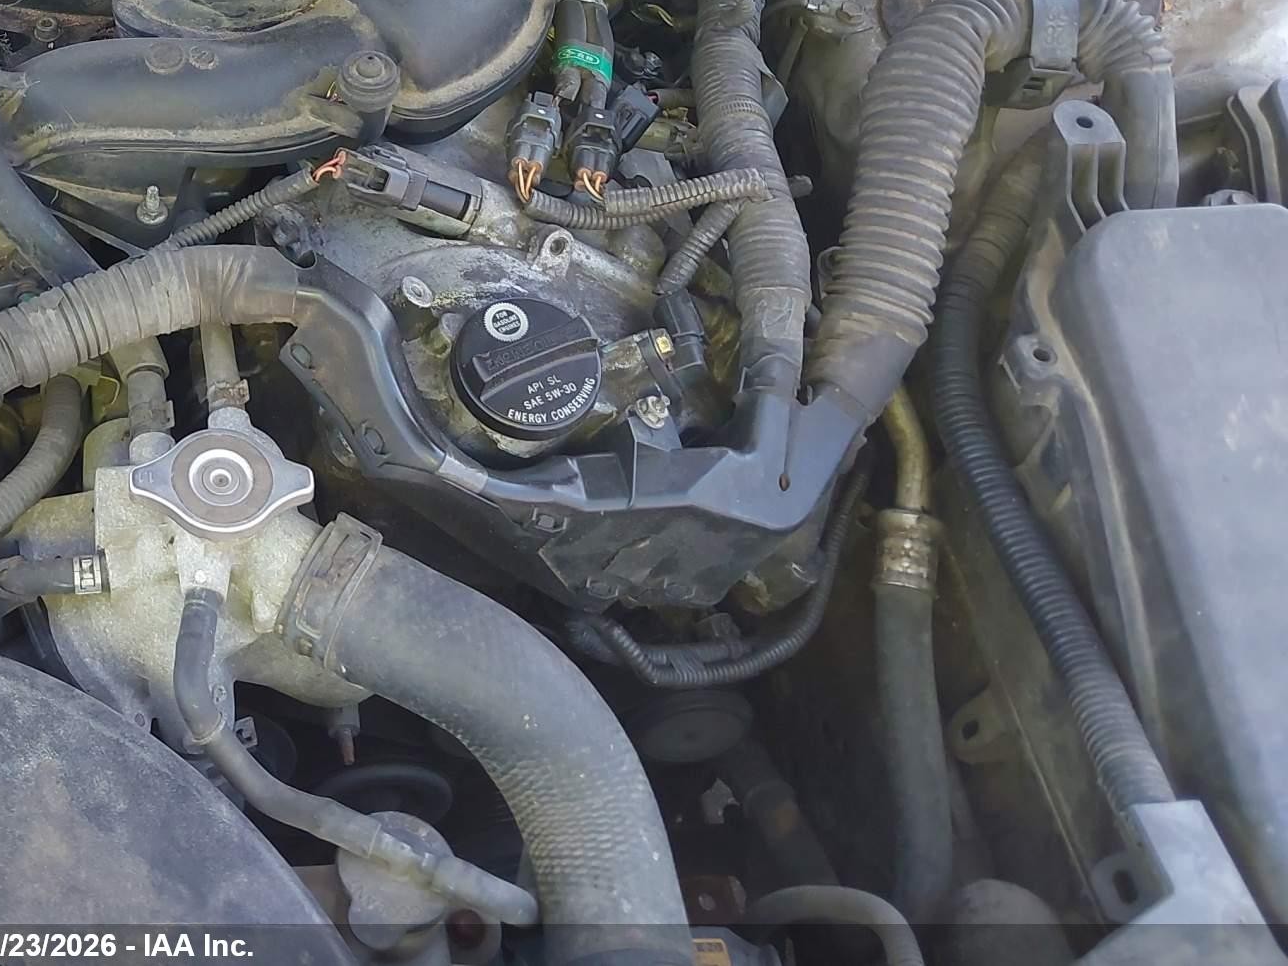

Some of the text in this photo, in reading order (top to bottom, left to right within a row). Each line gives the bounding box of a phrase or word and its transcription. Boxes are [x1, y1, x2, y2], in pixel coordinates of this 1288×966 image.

[493, 314, 519, 328] GASOLINE
[496, 310, 508, 320] FOR
[498, 320, 521, 334] ENGINES
[526, 374, 562, 395] API SL
[507, 377, 596, 424] ENERGY CONSERVING
[523, 382, 577, 411] SAE 5W-30
